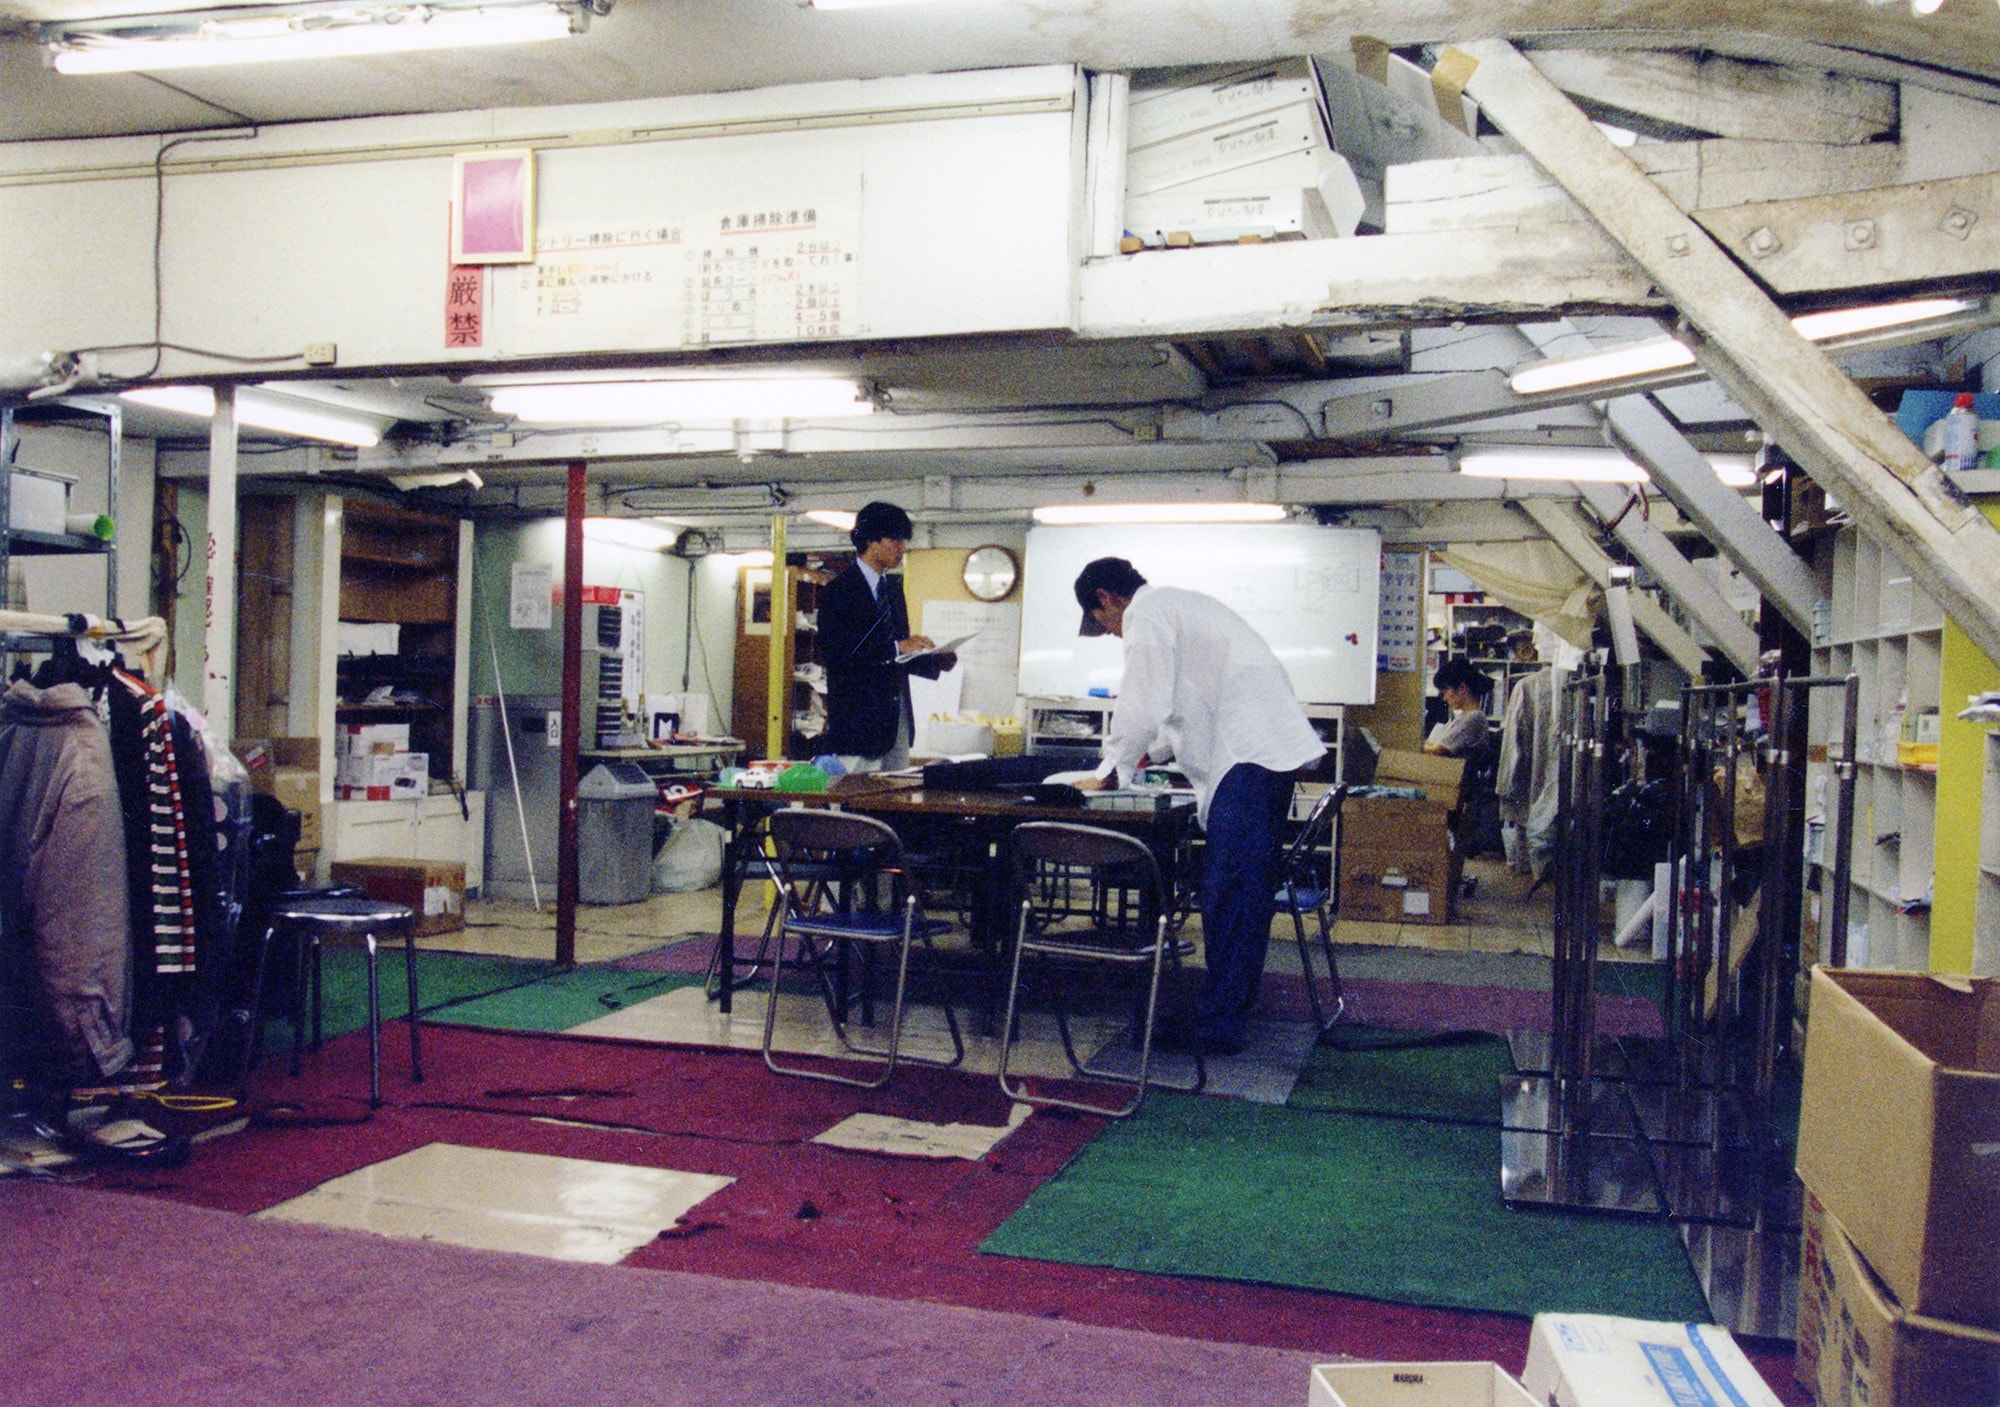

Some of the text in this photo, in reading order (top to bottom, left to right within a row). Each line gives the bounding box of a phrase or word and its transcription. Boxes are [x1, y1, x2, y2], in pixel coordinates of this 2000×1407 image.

[719, 209, 816, 230] 倉庫掃除準備
[536, 227, 681, 249] ントリー掃除に行く場合
[447, 266, 479, 344] 厳禁
